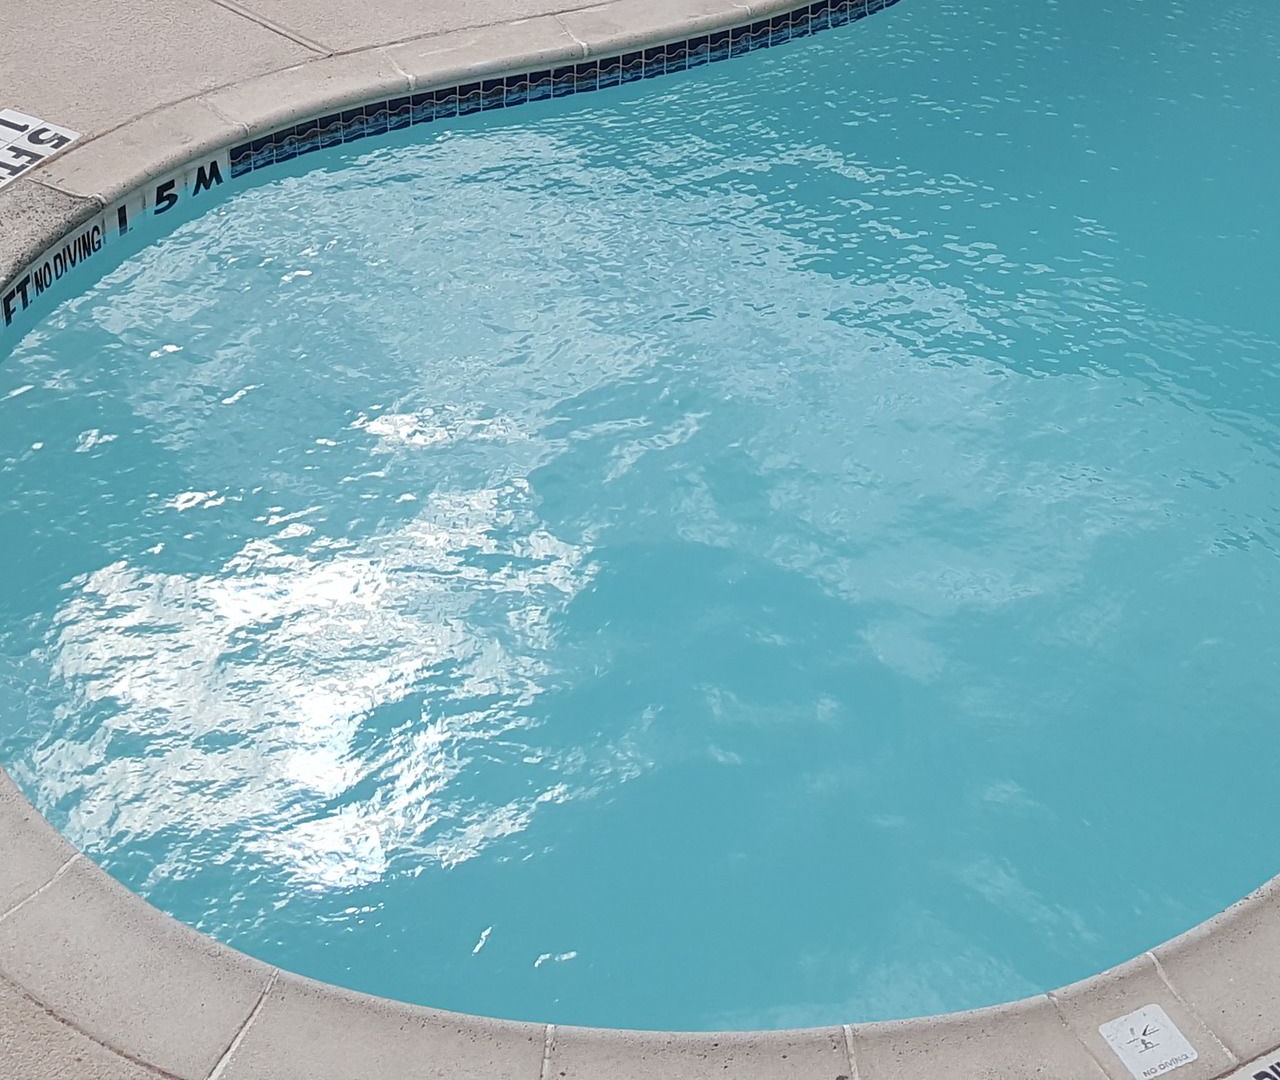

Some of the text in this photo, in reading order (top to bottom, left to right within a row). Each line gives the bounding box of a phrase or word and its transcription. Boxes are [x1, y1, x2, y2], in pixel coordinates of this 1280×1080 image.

[34, 269, 53, 297] NO
[55, 225, 102, 281] DIVING
[1143, 1054, 1189, 1077] NO DIVING
